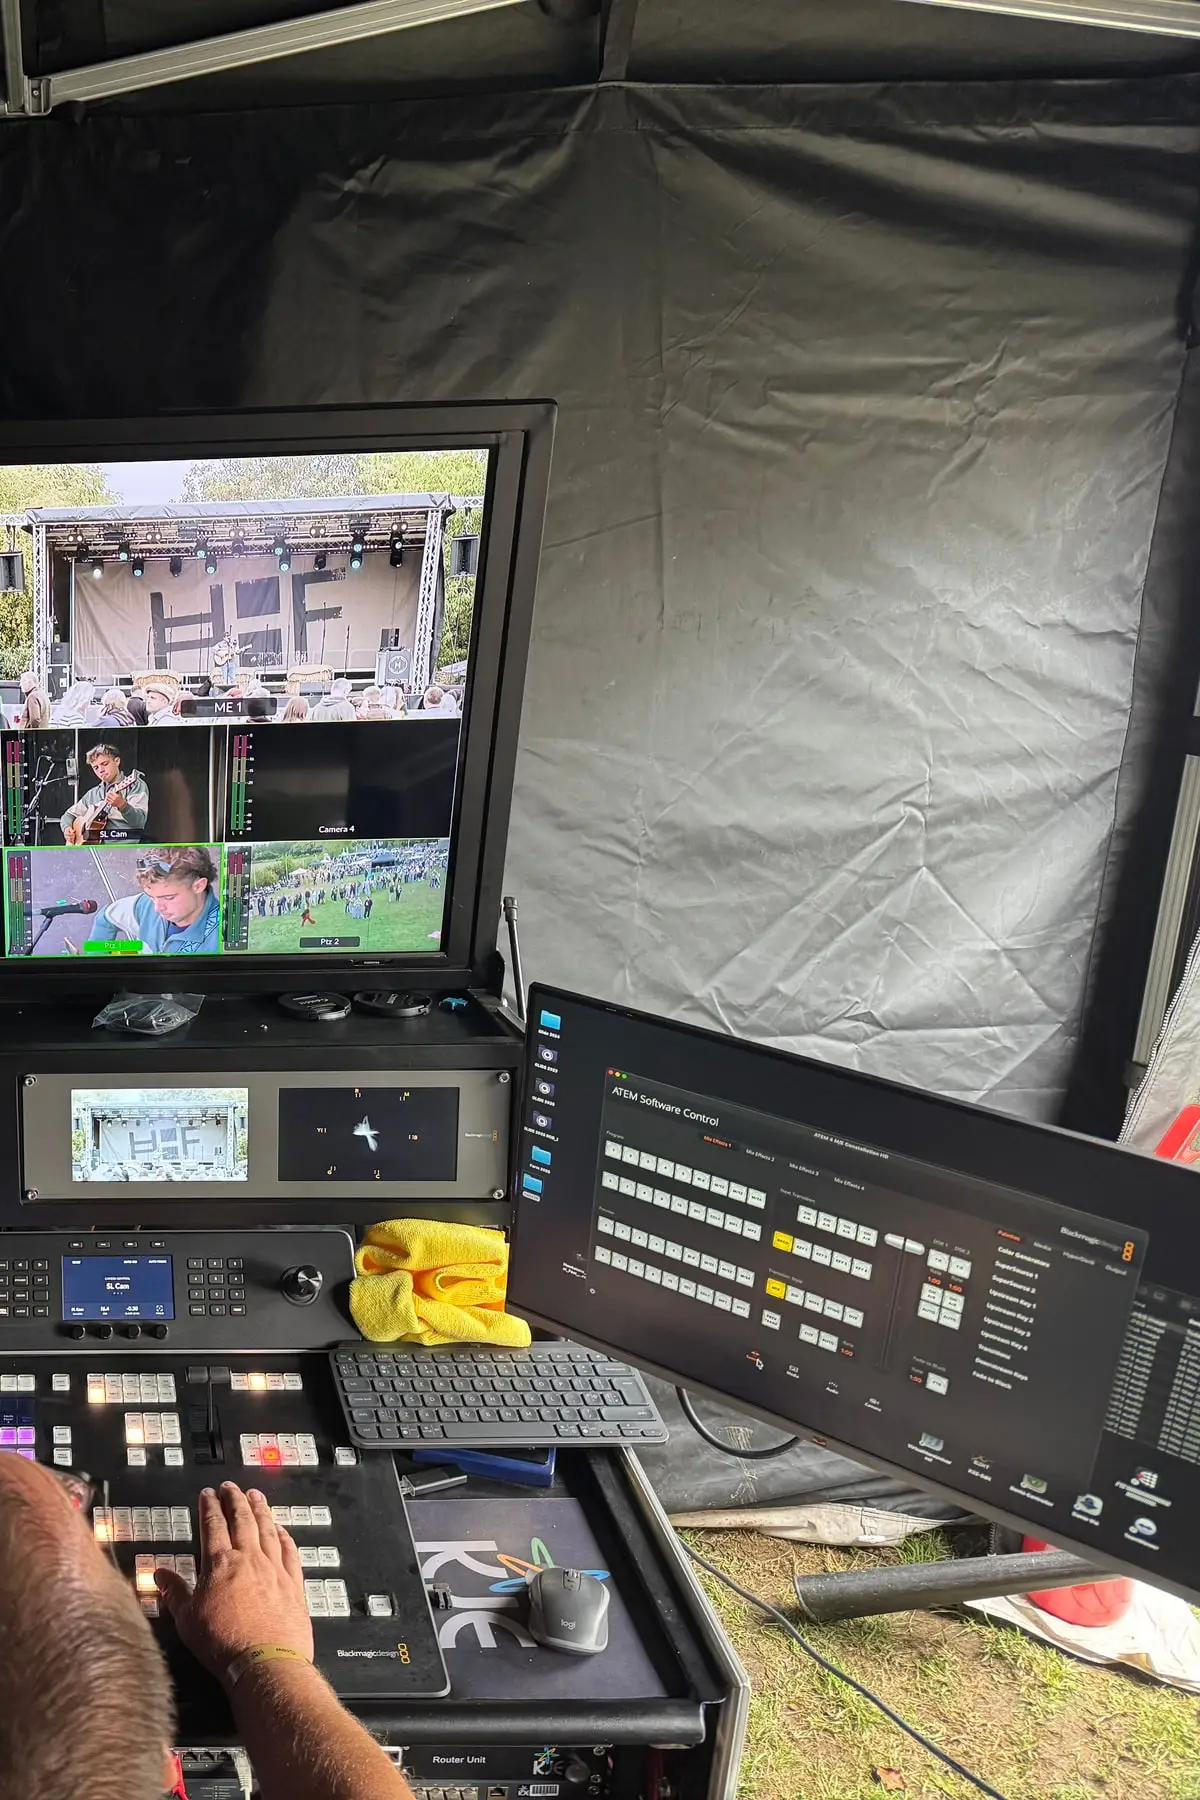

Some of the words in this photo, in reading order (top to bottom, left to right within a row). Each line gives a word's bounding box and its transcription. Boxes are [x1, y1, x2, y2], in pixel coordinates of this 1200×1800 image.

[214, 701, 233, 713] ME
[237, 701, 242, 713] 1
[100, 830, 108, 838] SL
[110, 830, 127, 838] Cam
[318, 825, 348, 833] Camera
[349, 825, 355, 833] 4
[320, 938, 332, 946] Ptz
[612, 1086, 638, 1101] ATEM
[640, 1094, 682, 1116] Software
[683, 1108, 720, 1128] Control
[712, 1137, 729, 1148] Effects
[813, 1132, 829, 1141] ATEM
[833, 1138, 844, 1147] M/E
[845, 1141, 880, 1158] Constellation
[880, 1152, 889, 1160] HD
[746, 1148, 755, 1156] Mix
[755, 1151, 771, 1161] Effects
[789, 1162, 798, 1170] Mix
[799, 1165, 815, 1175] Effects
[843, 1180, 860, 1190] Effects
[1060, 1226, 1122, 1252] Blackmagicdesign
[998, 1246, 1014, 1256] Color
[1015, 1251, 1050, 1268] Generators
[995, 1260, 1034, 1279] SuperSource
[1105, 1264, 1127, 1276] Output
[106, 1282, 114, 1290] SL
[114, 1282, 130, 1290] Cam
[928, 1276, 941, 1285] 1:00
[992, 1274, 1031, 1293] SuperSource
[949, 1283, 962, 1293] 1:00
[989, 1288, 1019, 1304] Upstream
[1019, 1297, 1032, 1309] Key
[986, 1302, 1016, 1318] Upstream
[1016, 1311, 1029, 1323] Key
[984, 1316, 1013, 1331] Upstream
[1013, 1324, 1026, 1336] Key
[981, 1330, 1010, 1345] Upstream
[1011, 1338, 1023, 1350] Key
[975, 1357, 1013, 1376] Downstream
[972, 1370, 988, 1381] Fade
[995, 1379, 1012, 1390] Black
[560, 1618, 576, 1630] logi
[337, 1649, 400, 1659] Blackmagicdesign
[432, 1756, 464, 1764] Router
[467, 1756, 486, 1764] Unit
